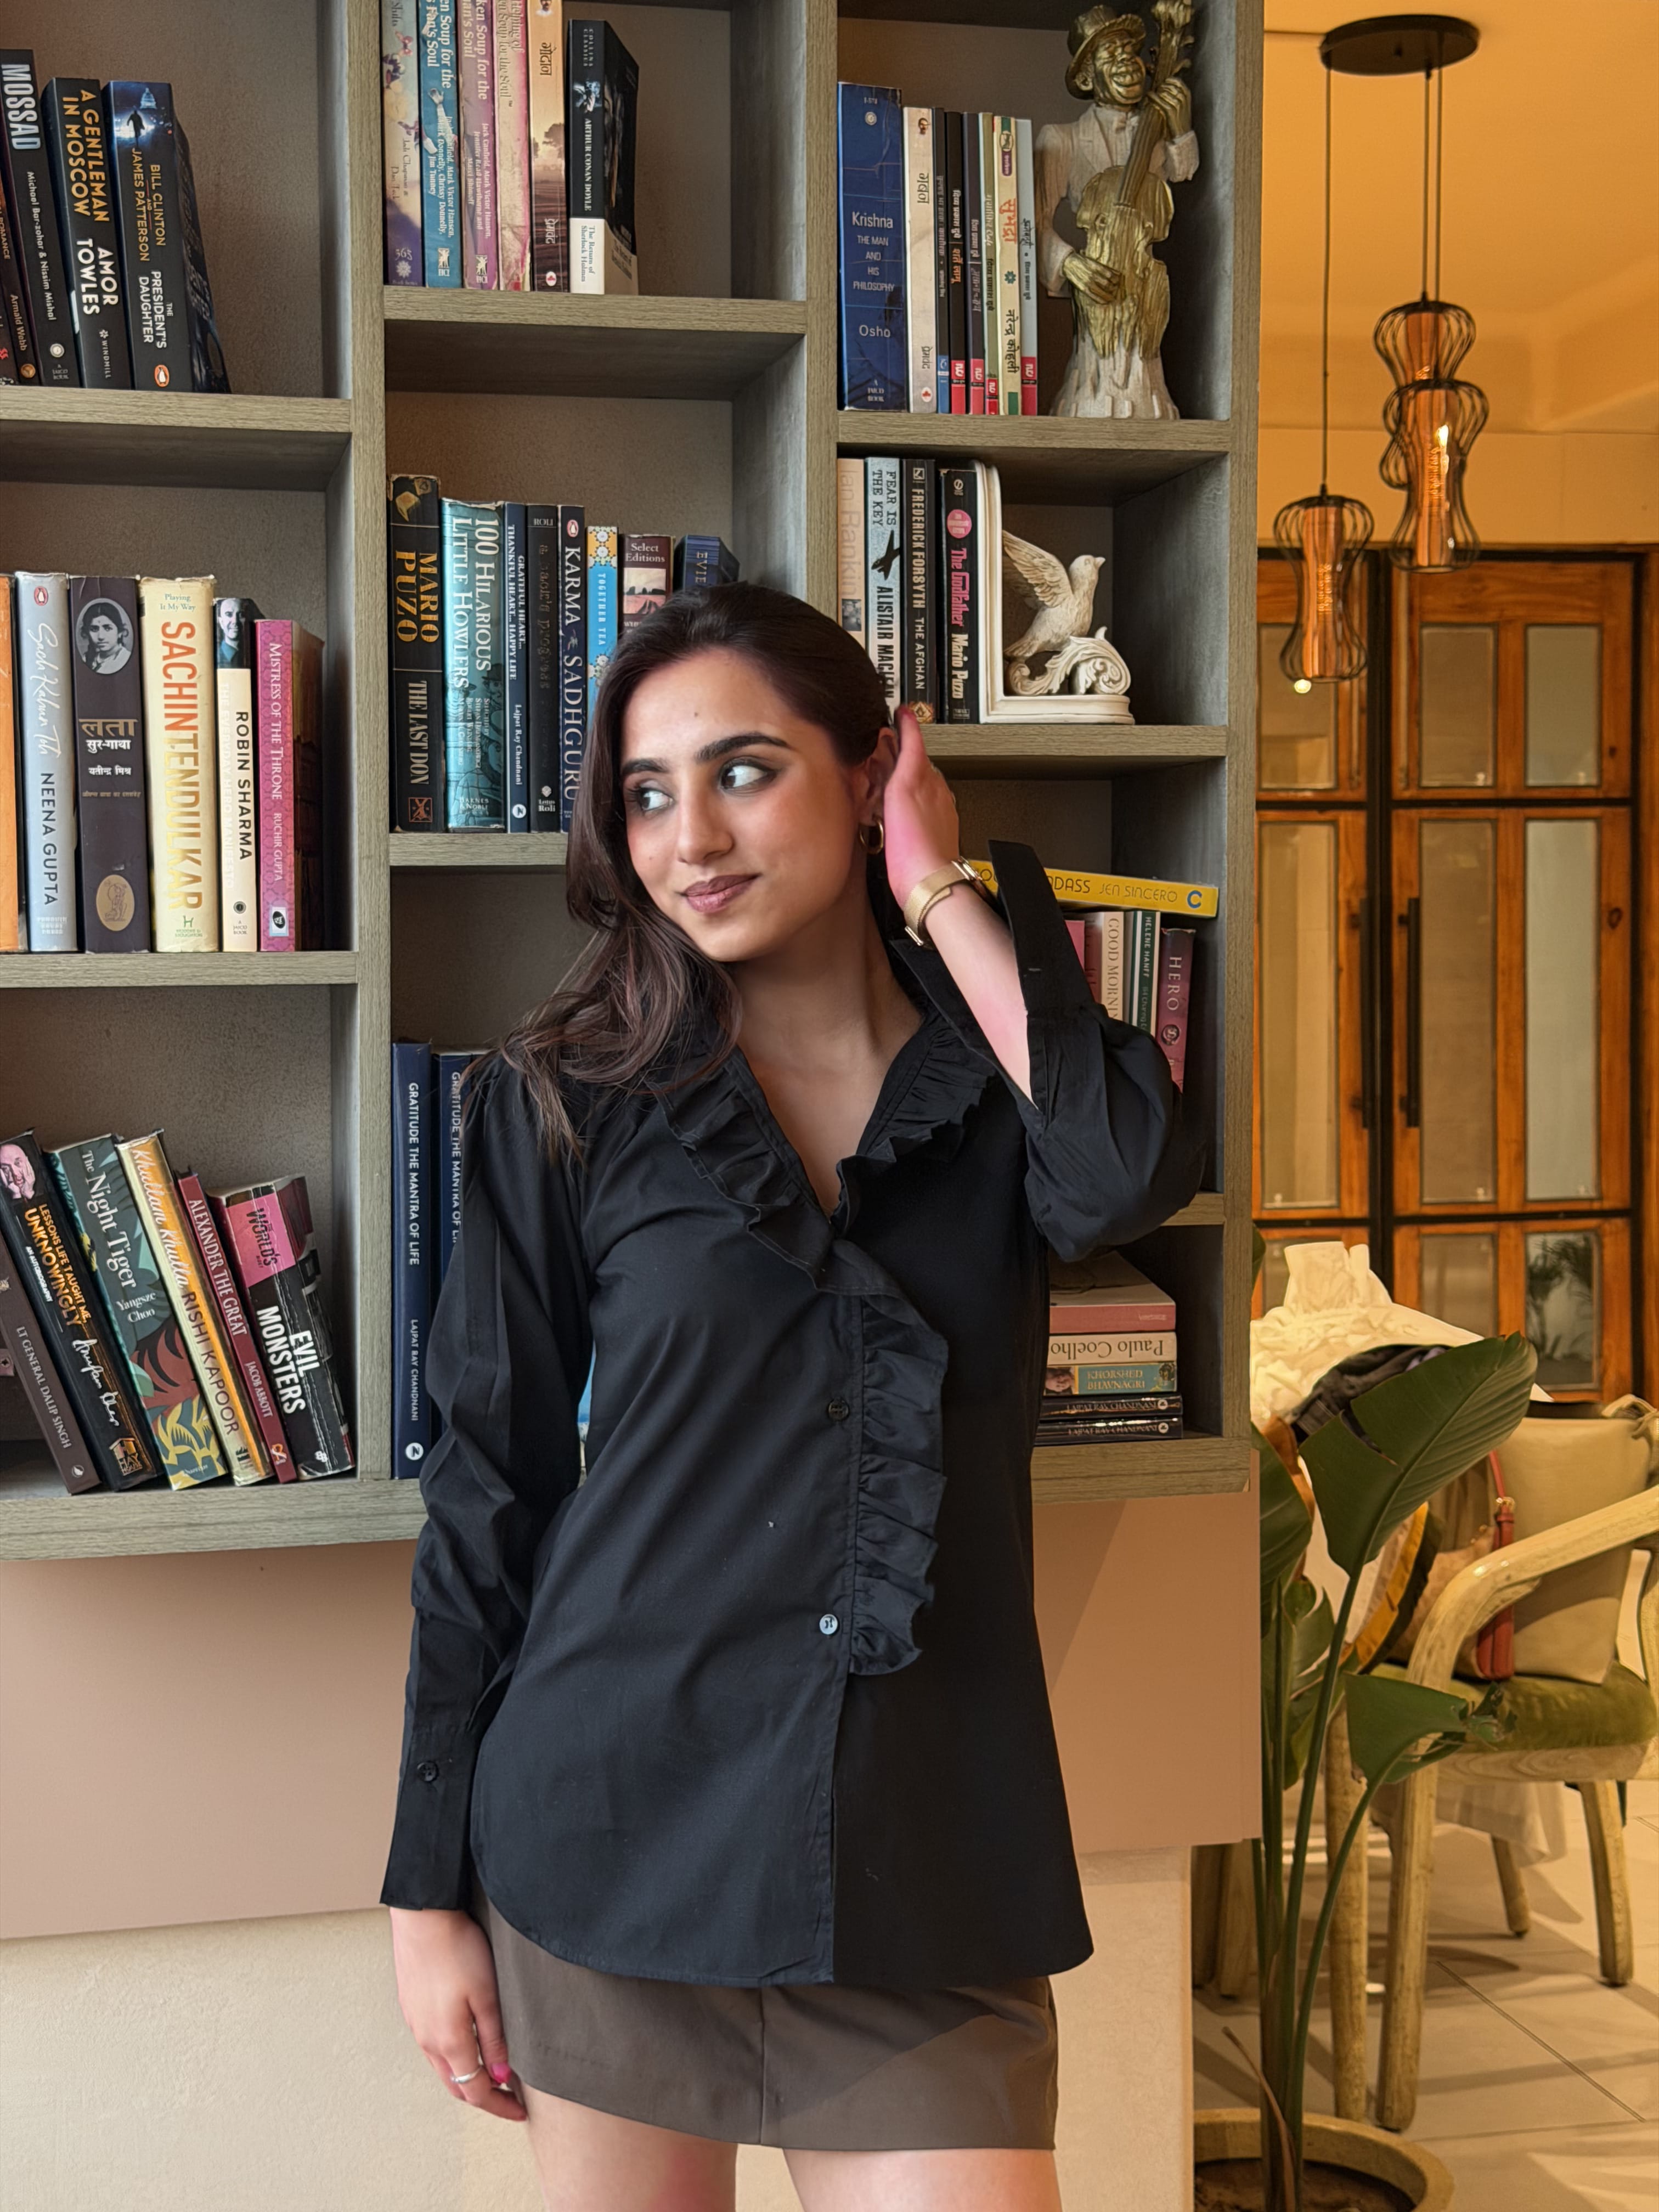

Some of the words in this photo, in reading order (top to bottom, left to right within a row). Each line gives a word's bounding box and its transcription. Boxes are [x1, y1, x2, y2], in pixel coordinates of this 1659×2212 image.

[438, 15, 452, 45] Soup
[464, 31, 476, 58] Soul
[474, 25, 487, 54] Soup
[427, 41, 440, 67] Soul
[441, 49, 454, 66] for
[477, 59, 489, 77] for
[540, 42, 556, 76] गोदान
[81, 89, 97, 101] A
[442, 70, 454, 88] the
[478, 81, 489, 100] the
[1, 64, 41, 149] MOSSAD
[62, 97, 80, 115] IN
[65, 125, 91, 216] MOSCOW
[83, 109, 109, 222] GENTLEMAN
[132, 148, 144, 187] JAMES
[150, 165, 161, 190] BILL
[428, 156, 436, 167] Jim
[27, 172, 36, 205] Michael
[428, 170, 437, 195] Tunney
[917, 173, 929, 204] गबन
[135, 191, 150, 261] PATTERSON
[153, 193, 166, 246] CLINTON
[544, 218, 558, 244] प्रेमचंद
[852, 211, 893, 229] Krishna
[1000, 199, 1017, 244] सुभद्रा
[857, 235, 870, 245] THE
[871, 236, 888, 246] MAN
[866, 252, 881, 261] AND
[41, 261, 49, 290] Nissim
[76, 238, 100, 314] TOWLES
[98, 247, 119, 305] AMOR
[853, 281, 895, 292] PHILOSOPHY
[44, 292, 57, 321] Mishal
[139, 276, 154, 343] DAUGHTER
[151, 271, 167, 348] PRESIDENT'S
[859, 325, 890, 338] Osho
[100, 340, 111, 379] WINDMILL
[1005, 339, 1020, 373] कोहली
[872, 470, 883, 496] THE
[887, 471, 896, 504] FEAR
[873, 501, 883, 527] KEY
[887, 511, 896, 526] IS
[912, 489, 925, 548] FREDERICK
[453, 518, 472, 584] LITTLE
[475, 518, 499, 555] 100
[631, 543, 659, 552] Select
[625, 552, 665, 562] Editions
[695, 551, 708, 583] EVIE
[841, 511, 861, 596] Rankin
[951, 548, 967, 569] The
[396, 550, 417, 642] PUZO
[565, 546, 581, 626] KARMA
[912, 551, 926, 608] FORSYTH
[165, 594, 191, 602] Playing
[419, 552, 439, 642] MARIO
[877, 586, 894, 640] ALISTAIR
[951, 572, 969, 627] Godfather
[475, 562, 495, 671] HILARIOUS
[915, 617, 924, 640] THE
[27, 623, 58, 670] Sach
[453, 591, 473, 689] HOWLERS
[951, 634, 968, 668] Mario
[161, 622, 198, 731] SACHIN
[269, 643, 282, 700] MISTRESS
[915, 643, 925, 690] AFGHAN
[408, 680, 427, 710] THE
[952, 670, 968, 699] Puzo
[271, 702, 281, 719] OF
[514, 704, 522, 727] Lajpat
[78, 719, 138, 737] लता
[236, 712, 250, 771] ROBIN
[271, 720, 282, 744] THE
[409, 714, 428, 750] LAST
[514, 730, 522, 743] Ray
[564, 655, 583, 800] SADHGURU
[86, 740, 131, 753] सुर-गाथा
[115, 765, 132, 775] मिश्र
[271, 746, 283, 800] THRONE
[410, 753, 429, 785] DON
[41, 773, 56, 836] NEENA
[238, 779, 252, 860] SHARMA
[164, 733, 202, 910] TENDULKAR
[273, 812, 282, 848] RUCHIR
[43, 843, 58, 905] GUPTA
[273, 850, 283, 882] GUPTA
[1099, 883, 1120, 897] JEN
[1124, 885, 1178, 902] SINCERO
[1107, 918, 1119, 960] GOOD
[1167, 957, 1182, 1011] HERO
[409, 1082, 419, 1144] GRATITUDE
[82, 1150, 95, 1172] The
[409, 1147, 419, 1169] THE
[86, 1171, 118, 1232] Night
[132, 1149, 167, 1225] Khullam
[409, 1172, 419, 1220] MANTRA
[410, 1222, 419, 1241] OF
[452, 1210, 461, 1226] OF
[246, 1207, 278, 1266] WORLD'S
[24, 1207, 82, 1325] UNKNOWINGLY
[39, 1203, 61, 1245] LESSONS
[56, 1245, 70, 1265] LIFE
[64, 1264, 86, 1305] TAUGHT
[106, 1231, 137, 1288] Tiger
[189, 1200, 224, 1271] ALEXANDER
[214, 1269, 232, 1297] THE
[223, 1296, 247, 1336] GREAT
[410, 1242, 420, 1266] LIFE
[116, 1292, 156, 1312] Yangsze
[127, 1307, 155, 1323] Choo
[16, 1326, 29, 1338] LT
[410, 1319, 419, 1347] LAJPAT
[22, 1339, 46, 1386] GENERAL
[182, 1291, 210, 1345] RISHI
[201, 1350, 239, 1435] KAPOOR
[256, 1306, 306, 1414] MONSTERS
[289, 1330, 320, 1377] EVIL
[1051, 1341, 1112, 1360] Coelho
[1118, 1340, 1163, 1358] Paulo
[41, 1385, 59, 1414] DALIP
[246, 1361, 259, 1387] JACOB
[255, 1387, 273, 1418] ABBOTT
[53, 1415, 72, 1449] SINGH
